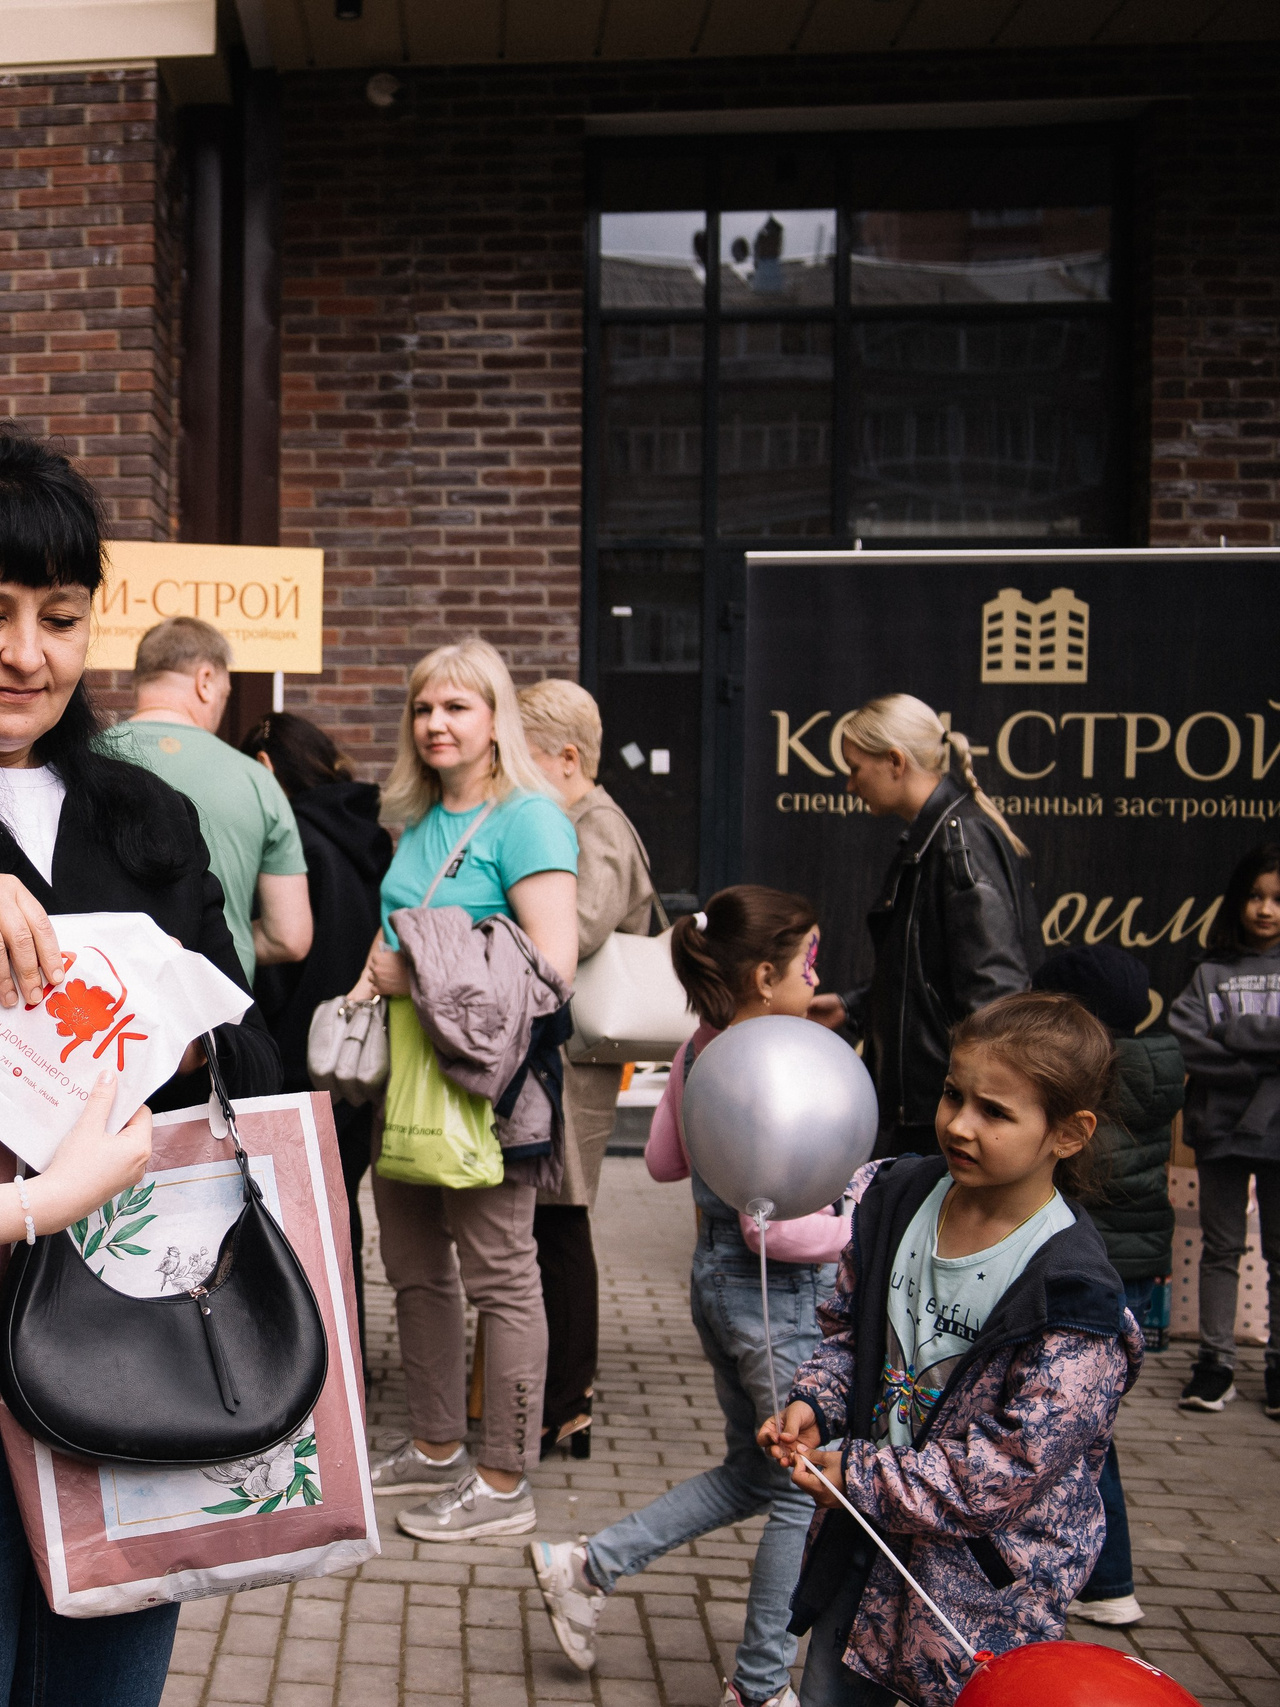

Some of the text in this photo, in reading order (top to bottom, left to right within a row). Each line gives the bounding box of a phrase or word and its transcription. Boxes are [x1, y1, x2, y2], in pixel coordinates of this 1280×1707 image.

[0, 1028, 70, 1086] домашнего
[22, 1075, 60, 1107] mak_irkutsk
[936, 1319, 975, 1341] GIRL
